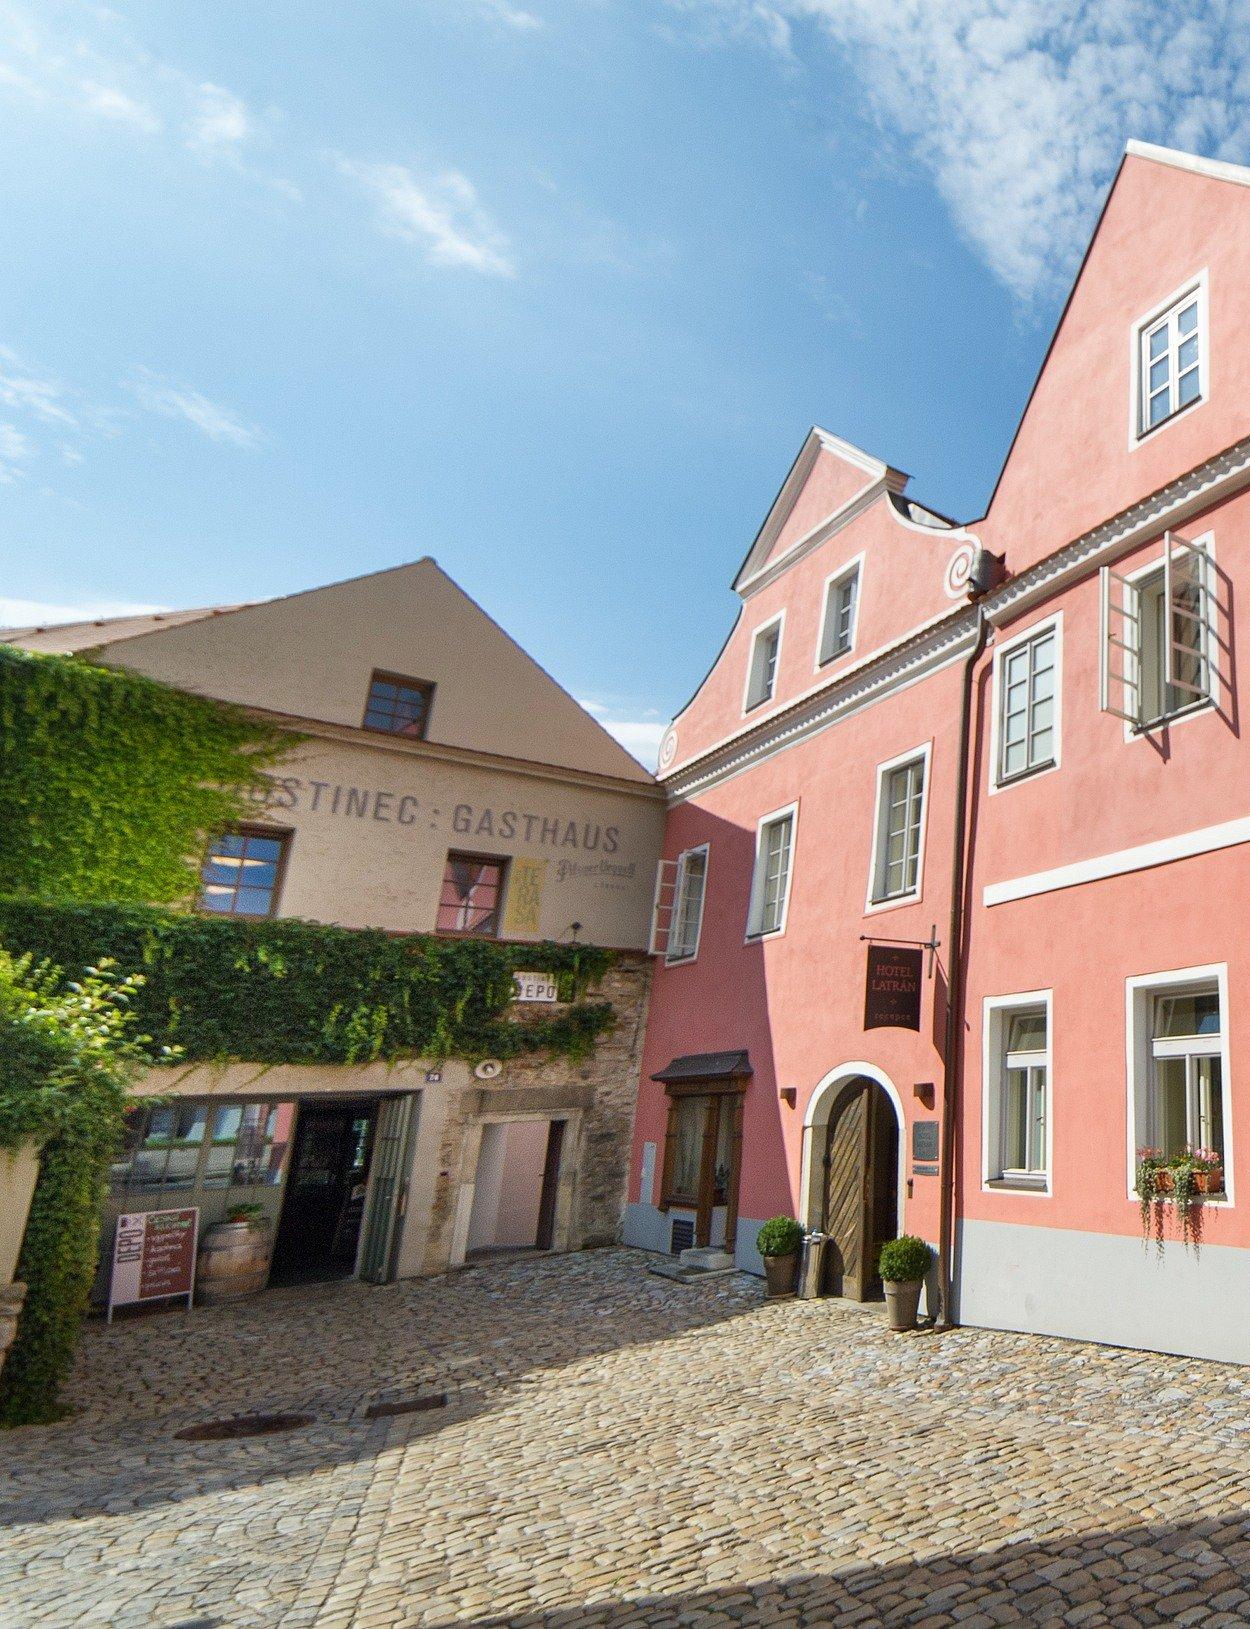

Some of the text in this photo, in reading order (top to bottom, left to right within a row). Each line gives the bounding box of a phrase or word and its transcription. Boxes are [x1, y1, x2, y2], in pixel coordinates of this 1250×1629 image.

[221, 777, 418, 825] OSTINEC
[452, 803, 621, 853] GASTHAUS
[876, 964, 914, 978] HOTEL
[117, 1229, 143, 1263] DEPO
